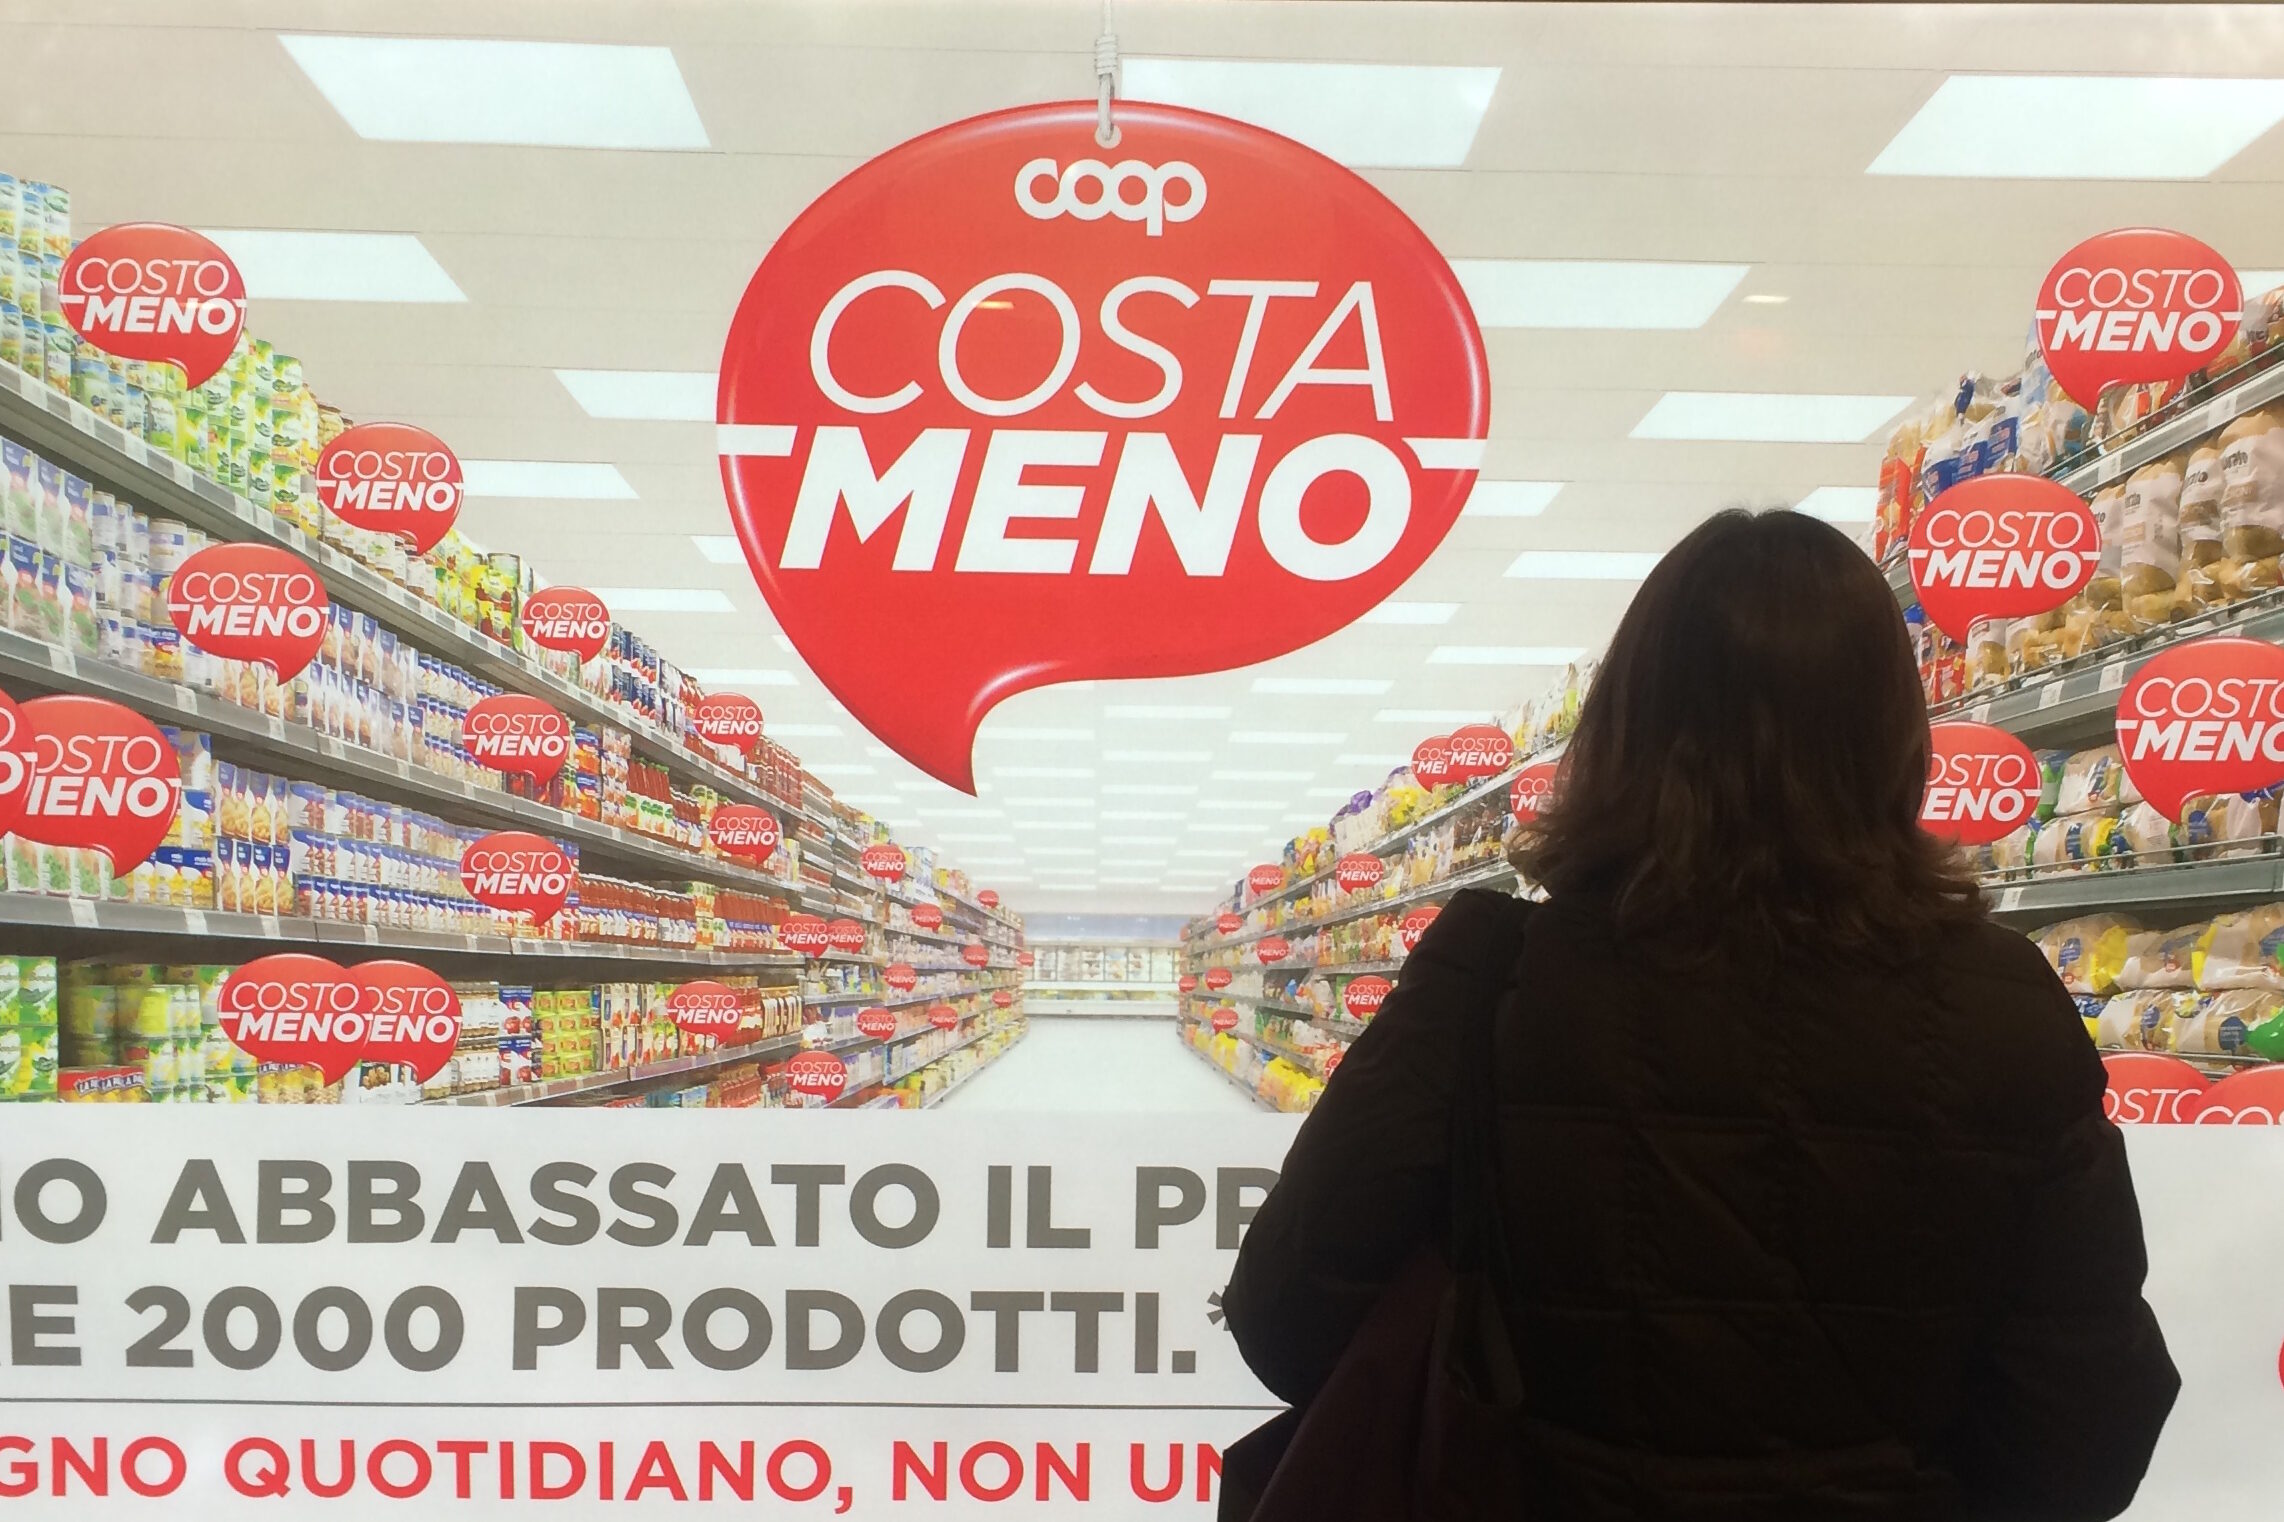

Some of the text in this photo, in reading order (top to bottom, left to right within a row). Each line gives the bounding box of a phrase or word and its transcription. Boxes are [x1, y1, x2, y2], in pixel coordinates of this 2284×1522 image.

[1014, 157, 1208, 237] coop
[76, 257, 230, 296] COSTO
[2055, 268, 2225, 309] COSTO
[82, 295, 236, 336] MENO
[809, 269, 1395, 422] COSTA
[2050, 311, 2223, 352] MENO
[329, 449, 451, 482] COSTO
[335, 481, 456, 512] MENO
[778, 425, 1413, 582] MENO
[1926, 510, 2084, 549] COSTO
[1921, 551, 2083, 589] MENO
[182, 571, 315, 605] COSTO
[187, 605, 321, 638] MENO
[529, 601, 603, 622] COSTO
[532, 620, 607, 640] MENO
[472, 711, 562, 737] COSTO
[699, 705, 758, 721] COSTO
[701, 720, 761, 736] MENO
[35, 734, 162, 776] OSTO
[475, 734, 566, 758] MENO
[1417, 748, 1447, 761] COS
[1450, 751, 1508, 767] MENO
[1451, 737, 1508, 752] COSTO
[1416, 760, 1448, 775] ME
[1926, 753, 2027, 787] OSTO
[1921, 788, 2024, 822] ENO
[714, 816, 774, 832] COSTO
[717, 830, 776, 846] MENO
[470, 849, 562, 876] COSTO
[474, 871, 567, 896] MENO
[783, 922, 828, 935] COSTO
[784, 933, 828, 945] MENO
[231, 981, 360, 1012] COSTO
[365, 986, 451, 1015] OSTO
[673, 994, 737, 1009] COSTO
[236, 1011, 365, 1043] MENO
[369, 1015, 455, 1044] ENO
[675, 1008, 739, 1025] MENO
[790, 1061, 842, 1074] COSTO
[792, 1073, 844, 1087] MENO
[0, 1158, 108, 1244] O
[154, 1158, 941, 1248] ABBASSATO
[988, 1165, 1091, 1248] IL
[0, 1284, 82, 1367] E
[124, 1285, 464, 1372] 2000
[224, 1436, 855, 1514] QUOTIDIANO,
[892, 1442, 1091, 1502] NON
